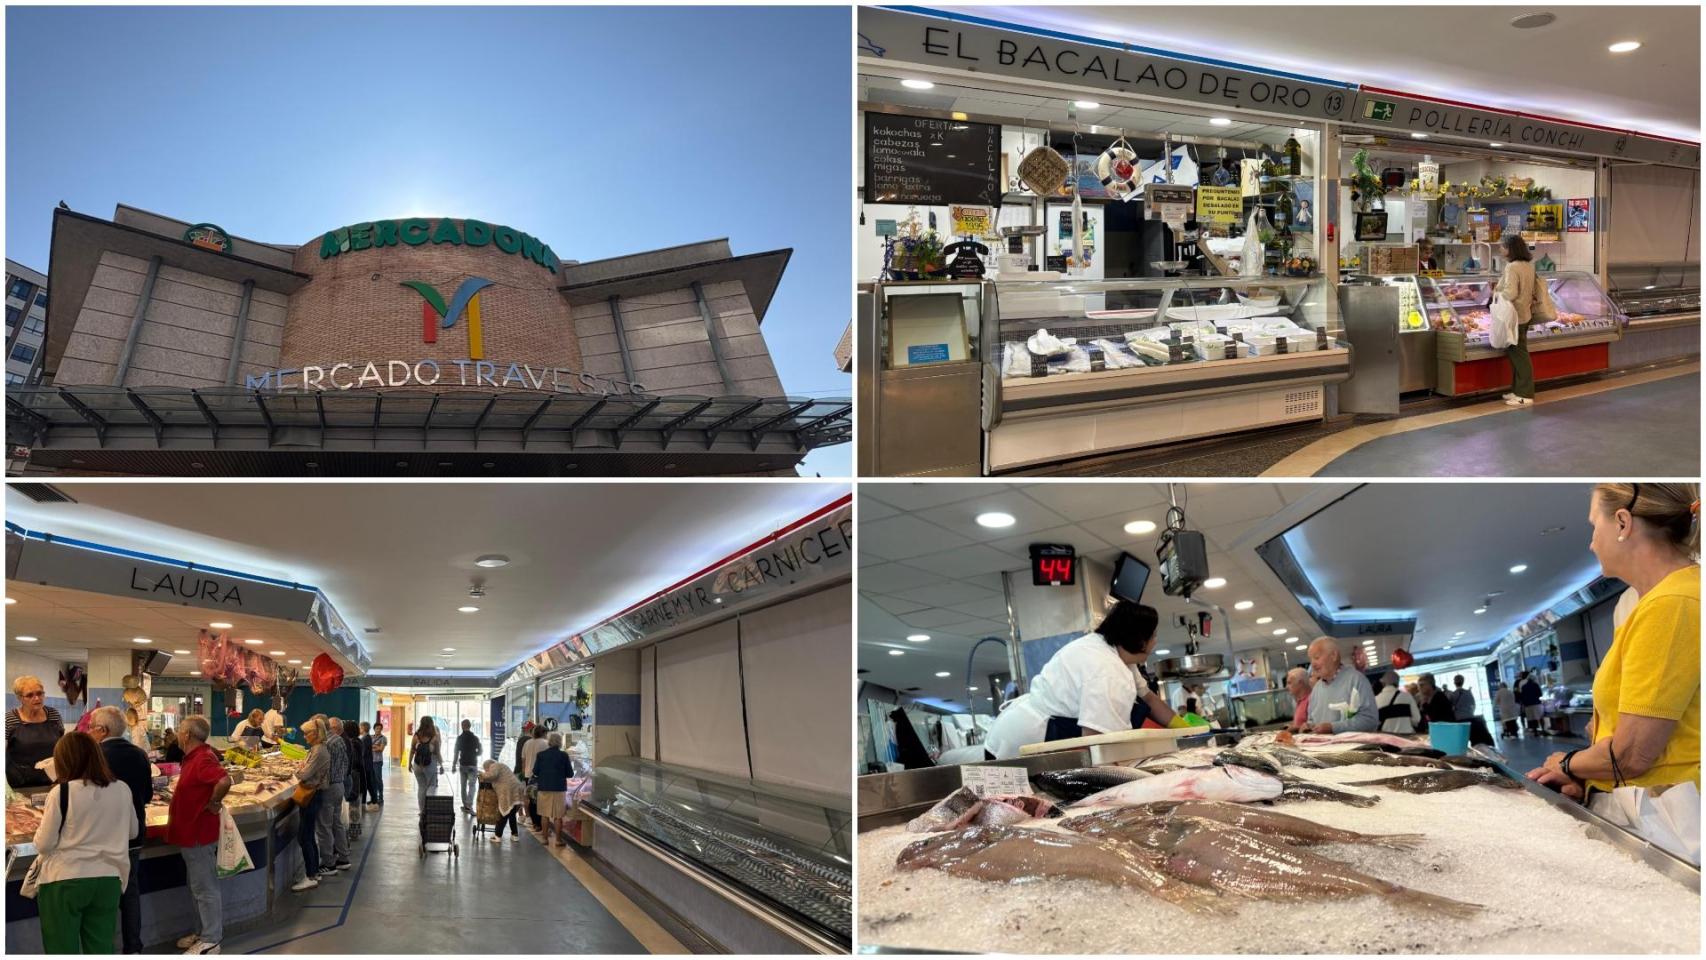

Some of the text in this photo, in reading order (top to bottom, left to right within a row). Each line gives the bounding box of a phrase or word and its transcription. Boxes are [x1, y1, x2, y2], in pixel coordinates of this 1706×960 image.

[922, 26, 1312, 108] EL BACALAO DE ORO
[1327, 95, 1342, 111] 13
[873, 126, 922, 139] kokochas
[1521, 125, 1585, 148] CONCHI
[873, 140, 921, 149] cabezas
[873, 162, 907, 174] migas
[319, 217, 558, 274] MERCADONA
[245, 359, 441, 395] MERCADO
[1040, 559, 1071, 580] 44
[131, 567, 242, 606] LAURA
[1359, 624, 1393, 635] LAURA
